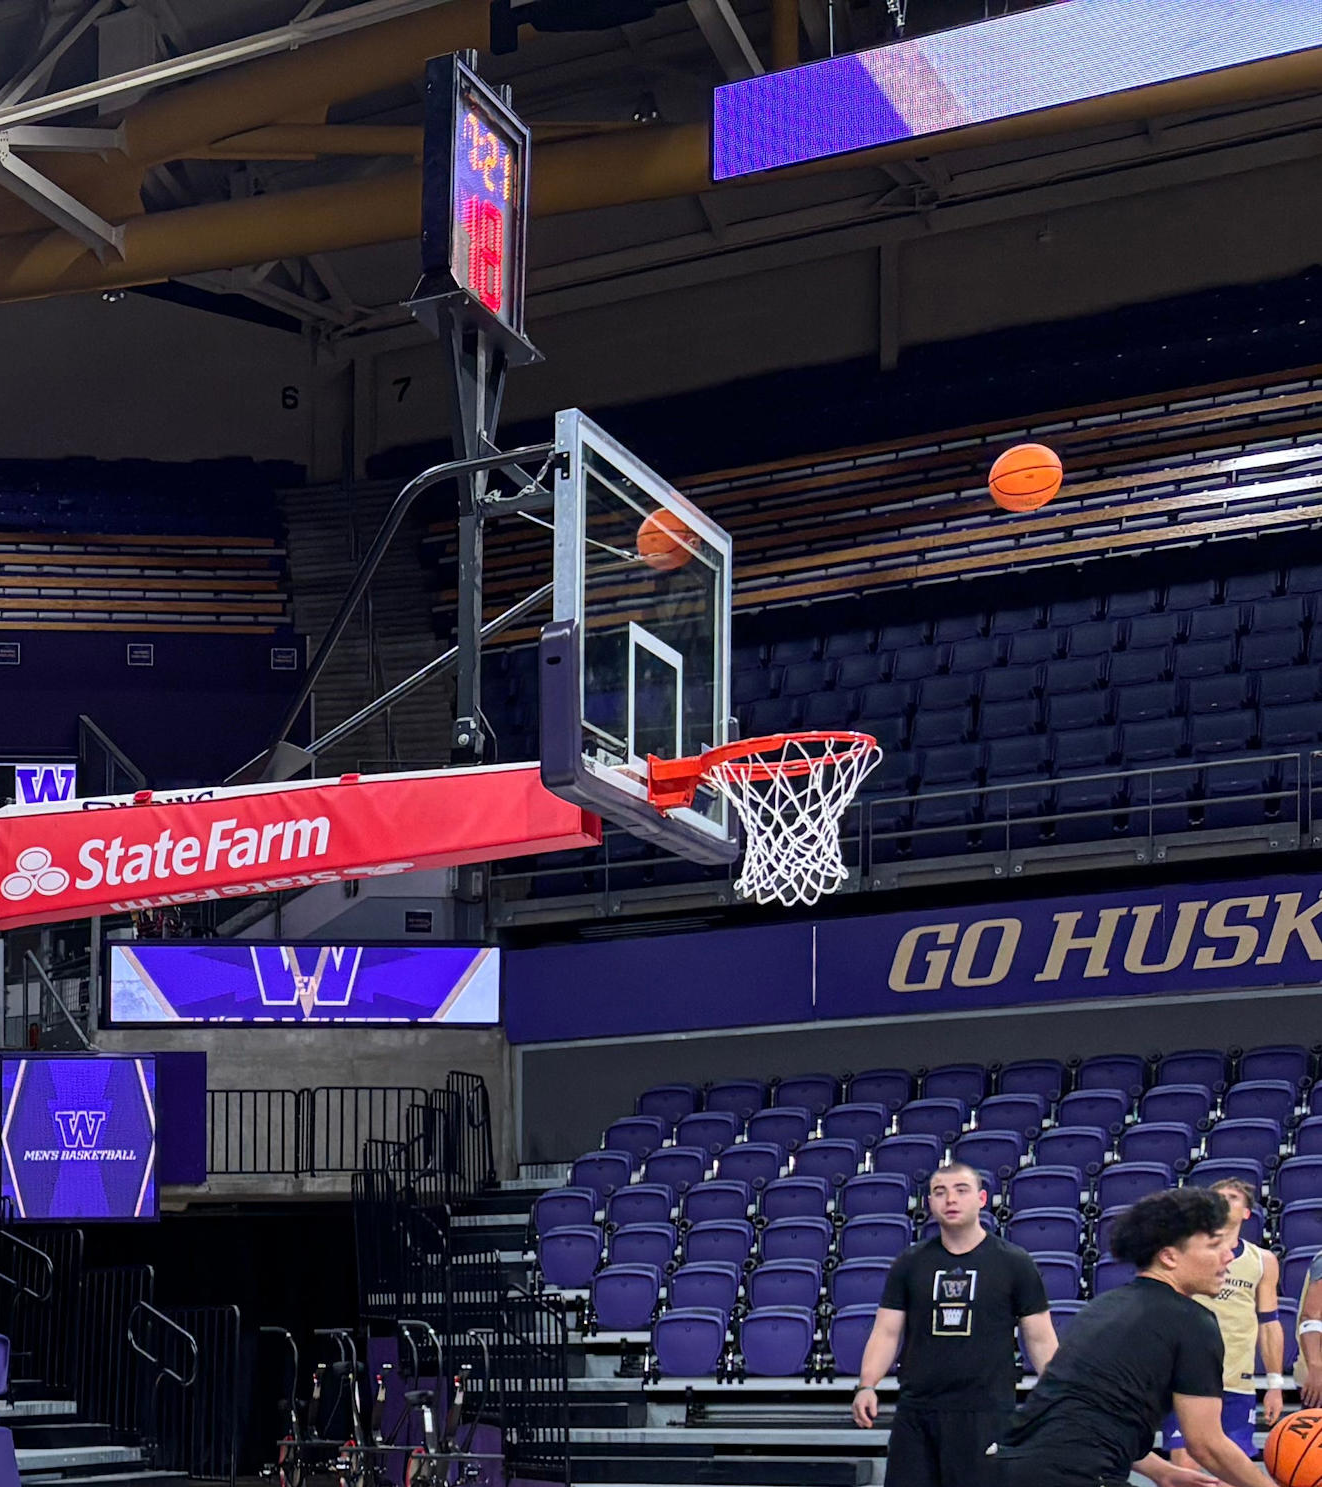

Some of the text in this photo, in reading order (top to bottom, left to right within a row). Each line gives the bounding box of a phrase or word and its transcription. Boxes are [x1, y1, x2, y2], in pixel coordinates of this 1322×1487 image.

[281, 386, 299, 409] 6
[392, 377, 412, 402] 7
[16, 769, 75, 804] W
[887, 891, 1322, 993] GO HUSK
[54, 1110, 106, 1149] W
[60, 1149, 137, 1161] BASKETBALL
